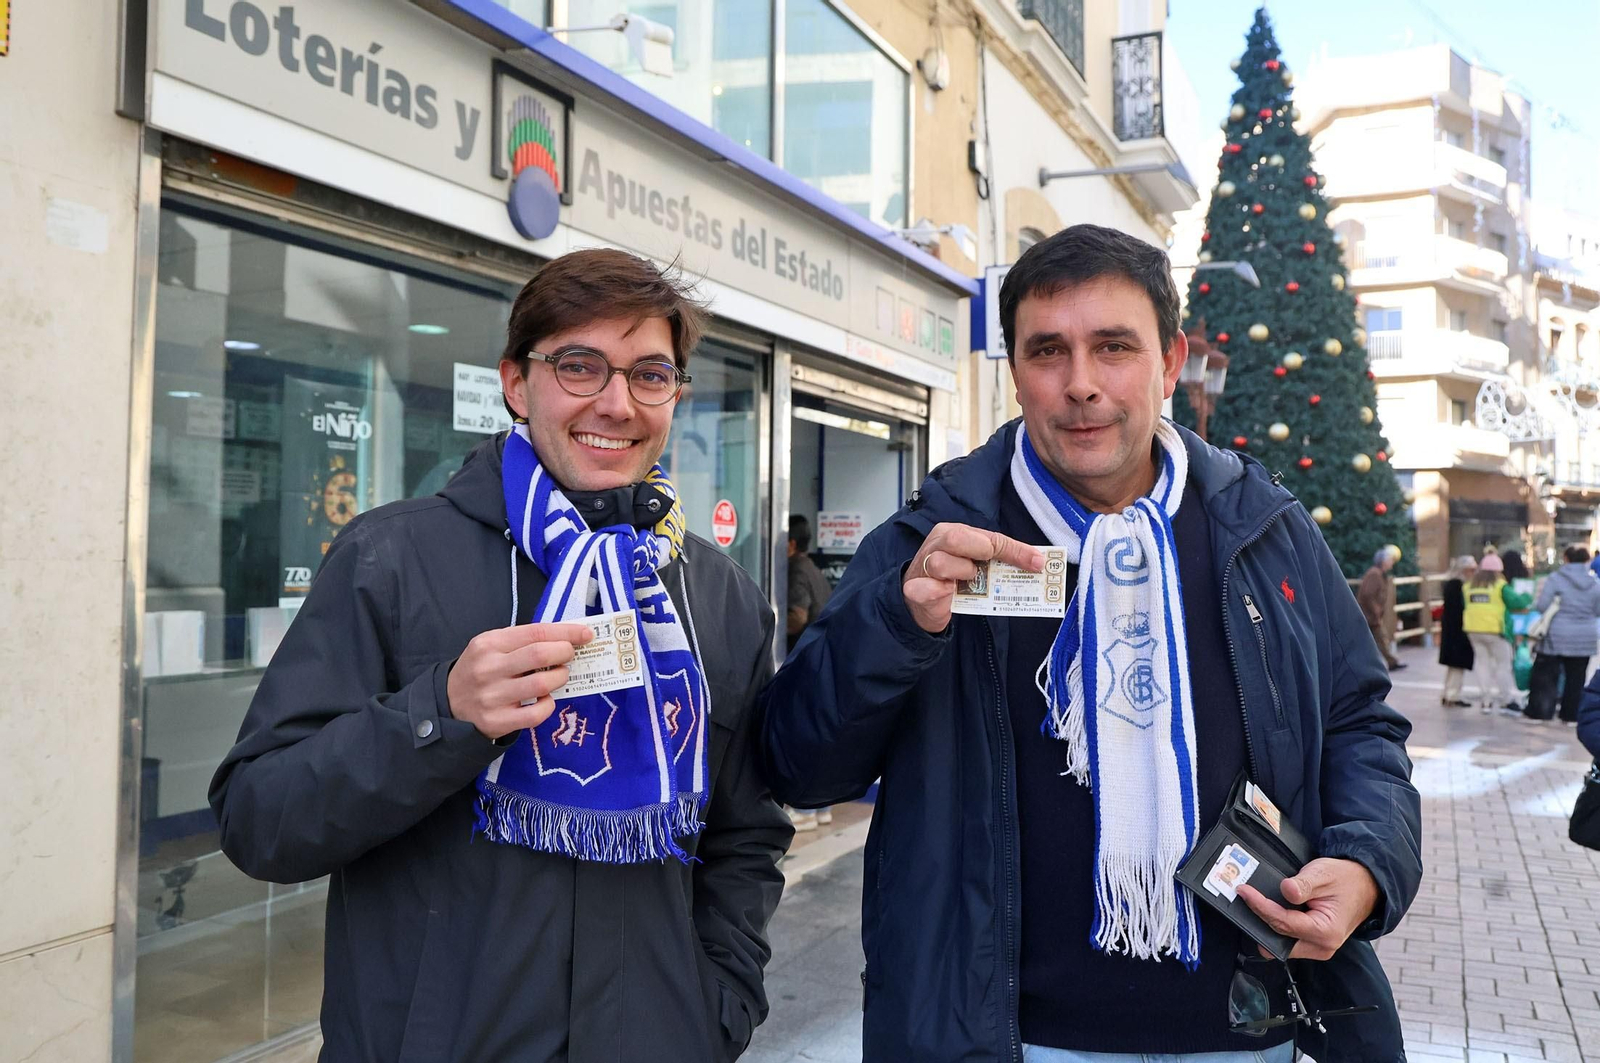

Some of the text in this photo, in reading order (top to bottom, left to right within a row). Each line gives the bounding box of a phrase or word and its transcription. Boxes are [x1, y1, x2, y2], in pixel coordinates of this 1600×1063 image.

[185, 0, 481, 161] Loterías y
[578, 147, 844, 302] Apuestas del Estado
[480, 415, 494, 429] 20
[284, 566, 312, 581] 770
[624, 657, 633, 665] 20
